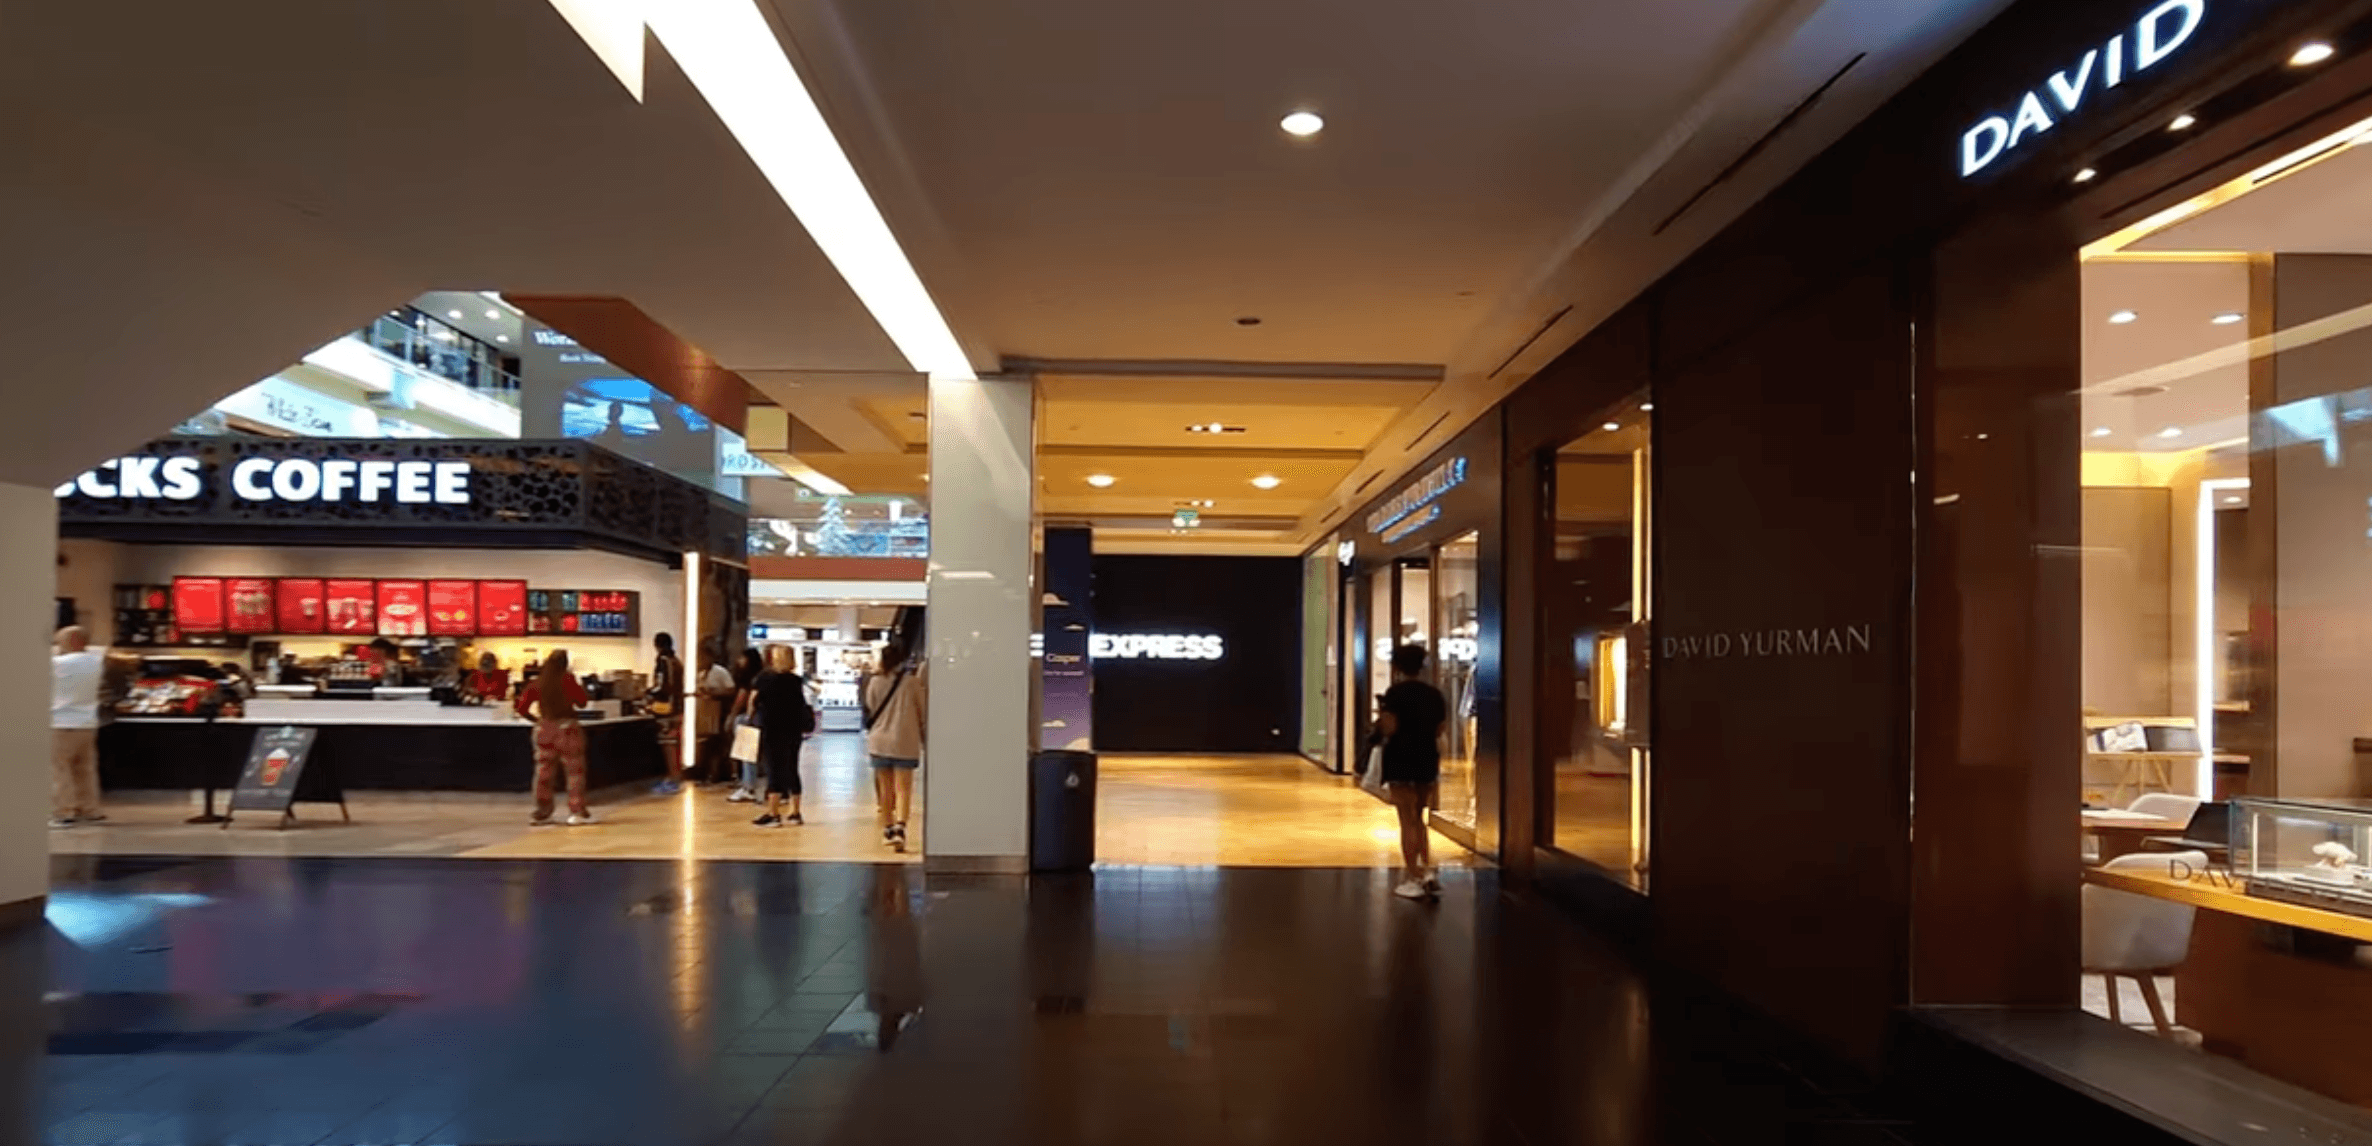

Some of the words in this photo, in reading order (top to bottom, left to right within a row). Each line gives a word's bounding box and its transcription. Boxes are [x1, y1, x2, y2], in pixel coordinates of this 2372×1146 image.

[1962, 0, 2204, 176] DAVID
[54, 457, 200, 499] CKS
[233, 458, 471, 503] COFFEE
[1089, 633, 1223, 660] EXPRESS
[1662, 632, 1732, 659] DAVID
[1739, 624, 1870, 657] YURMAN
